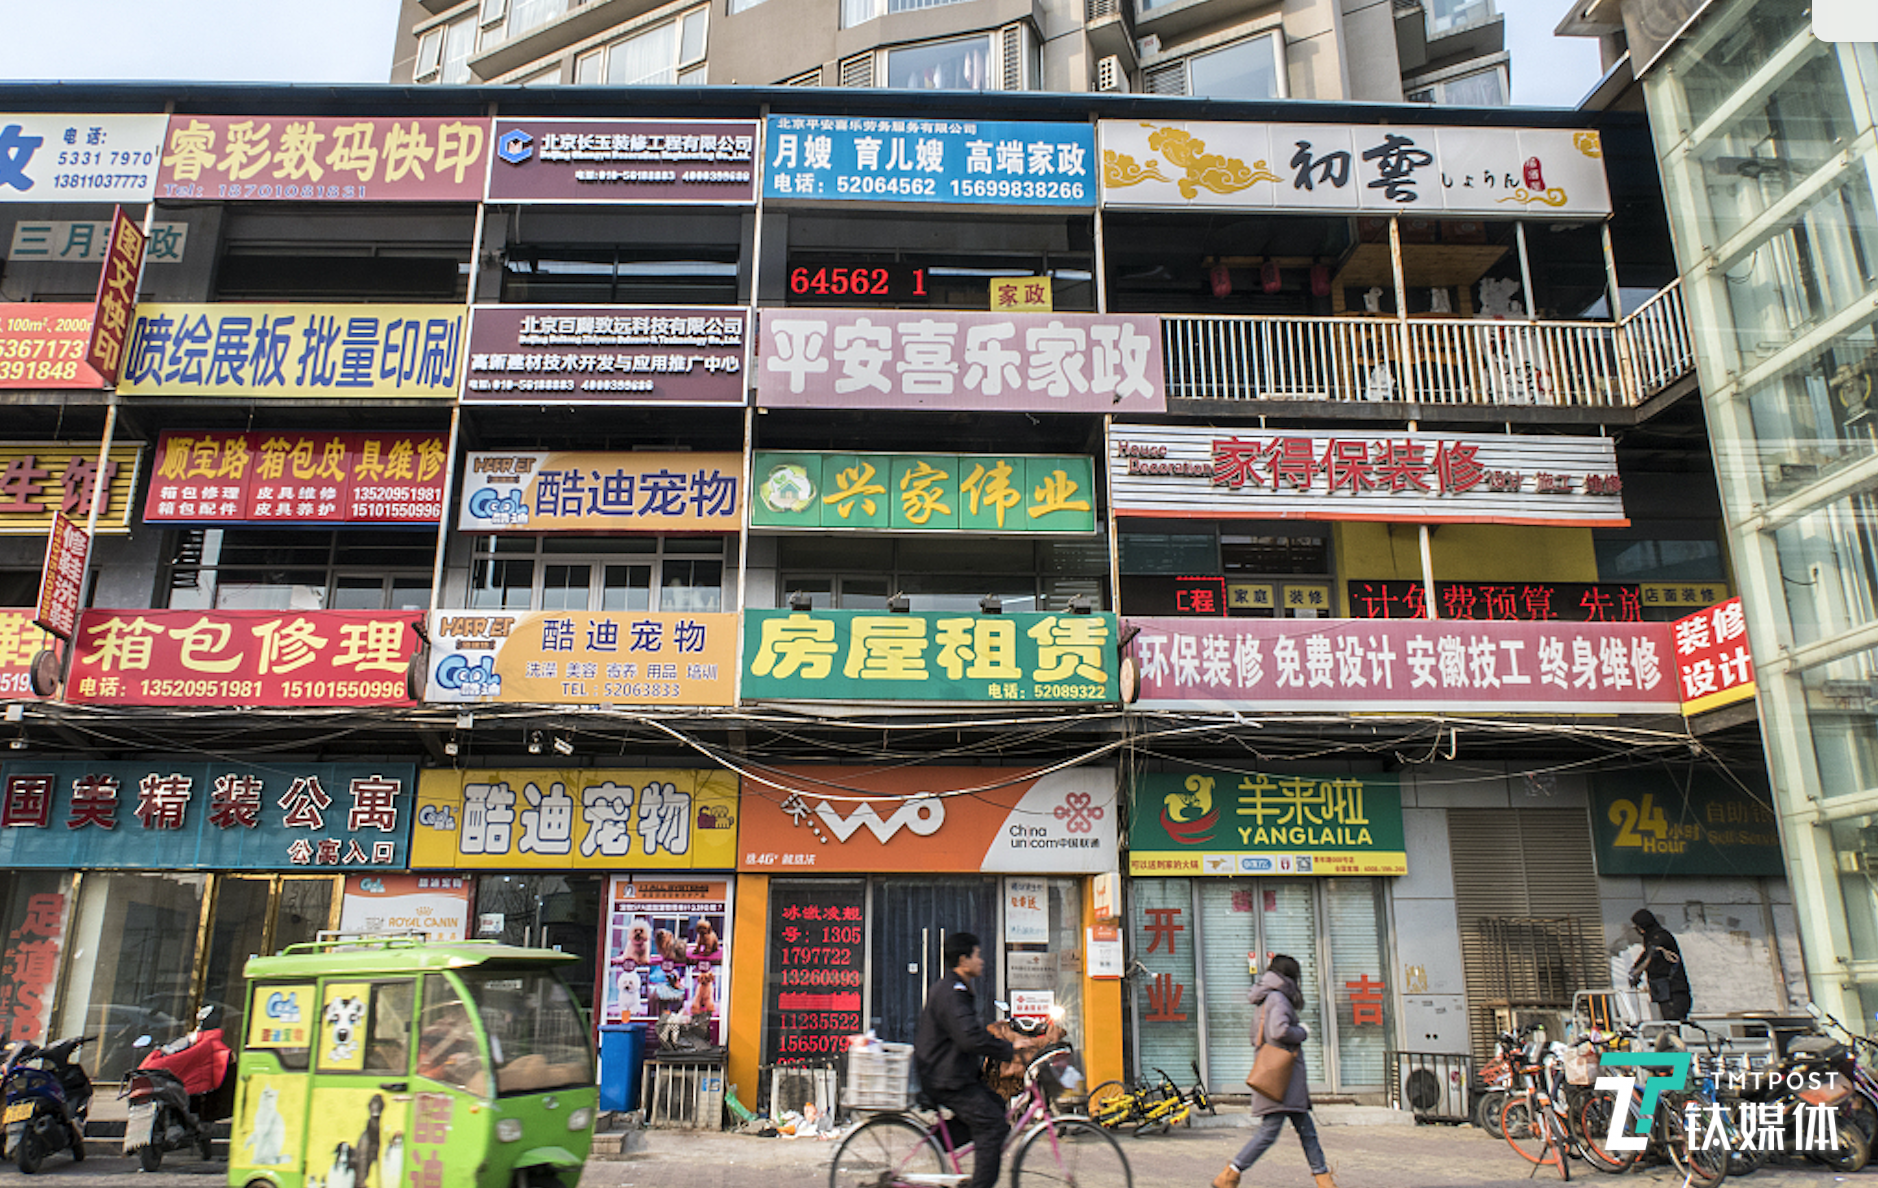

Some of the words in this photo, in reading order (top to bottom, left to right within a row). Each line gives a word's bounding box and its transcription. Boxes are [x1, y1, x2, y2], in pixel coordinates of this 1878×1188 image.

[776, 117, 978, 136] 北京平安喜乐劳务服务有限公司
[58, 151, 101, 165] 5331
[110, 151, 152, 165] 7970
[162, 119, 485, 184] 睿彩数码快印
[772, 133, 833, 170] 月嫂
[853, 136, 945, 174] 育儿嫂
[965, 139, 1087, 177] 高端家政
[53, 174, 148, 189] 13811037773
[836, 176, 937, 196] 52064562
[950, 179, 1085, 200] 15699838266
[14, 224, 183, 259] 三月政
[93, 215, 143, 372] 图文快印
[790, 267, 889, 295] 64562
[912, 269, 927, 296] 1
[998, 283, 1046, 307] 家政
[0, 338, 88, 359] 5367173
[124, 314, 296, 388] 喷绘展板
[295, 314, 463, 389] 批量印刷
[766, 317, 1155, 399] 平安喜乐家政
[1117, 440, 1167, 458] House
[1128, 458, 1212, 475] Decoration
[1211, 436, 1486, 494] 家得保装修
[1487, 471, 1524, 491] 设计
[0, 455, 118, 515] 生馆
[159, 486, 241, 499] 箱包修理
[256, 486, 337, 499] 皮具维修
[353, 486, 442, 501] 13520951981
[535, 469, 738, 517] 酷迪宠物
[822, 460, 1092, 529] 兴家伟业
[157, 502, 238, 516] 箱包配件
[254, 502, 335, 517] 皮具养护
[351, 502, 442, 518] 15101550996
[1233, 588, 1269, 604] 家庭
[1288, 589, 1323, 605] 装修
[1353, 583, 1558, 621] 计免费预算
[1644, 587, 1716, 603] 店面装修
[541, 619, 707, 653] 酷迪宠物
[1675, 602, 1746, 657] 装修
[81, 616, 411, 675] 箱包修理
[751, 613, 1109, 683] 房屋租赁
[525, 662, 558, 679] 洗澡
[565, 662, 598, 680] 美容
[606, 663, 637, 680] 寄养
[646, 664, 678, 680] 用品
[686, 664, 719, 680] 培训
[1138, 633, 1265, 688] 环保装修
[1273, 634, 1397, 690] 免费设计
[1406, 634, 1532, 690] 安徽技工
[1538, 635, 1663, 691] 终身维修
[1682, 646, 1753, 699] 设计
[140, 680, 263, 698] 13520951981
[280, 681, 406, 699] 15101550996
[603, 683, 681, 698] 52063833
[1034, 684, 1107, 700] 52089322
[0, 773, 401, 832] 国美精装公寓
[1236, 775, 1370, 825] 羊来啦
[459, 781, 692, 857] 酷迪宠物
[1010, 824, 1047, 837] China
[1608, 793, 1669, 848] 24
[1237, 826, 1374, 846] YANGLAILA
[1668, 822, 1701, 842] 小时
[286, 839, 395, 865] 公寓入口
[1642, 837, 1688, 855] Hour
[388, 917, 421, 928] ROYAL
[424, 917, 459, 928] CANIN
[822, 926, 861, 944] 1305
[781, 947, 851, 966] 1797722
[1144, 908, 1188, 1022] 开业
[780, 969, 860, 987] 13260393
[1345, 974, 1385, 1026] 吉
[779, 1014, 860, 1031] 11235522
[779, 1035, 850, 1053] 1565079
